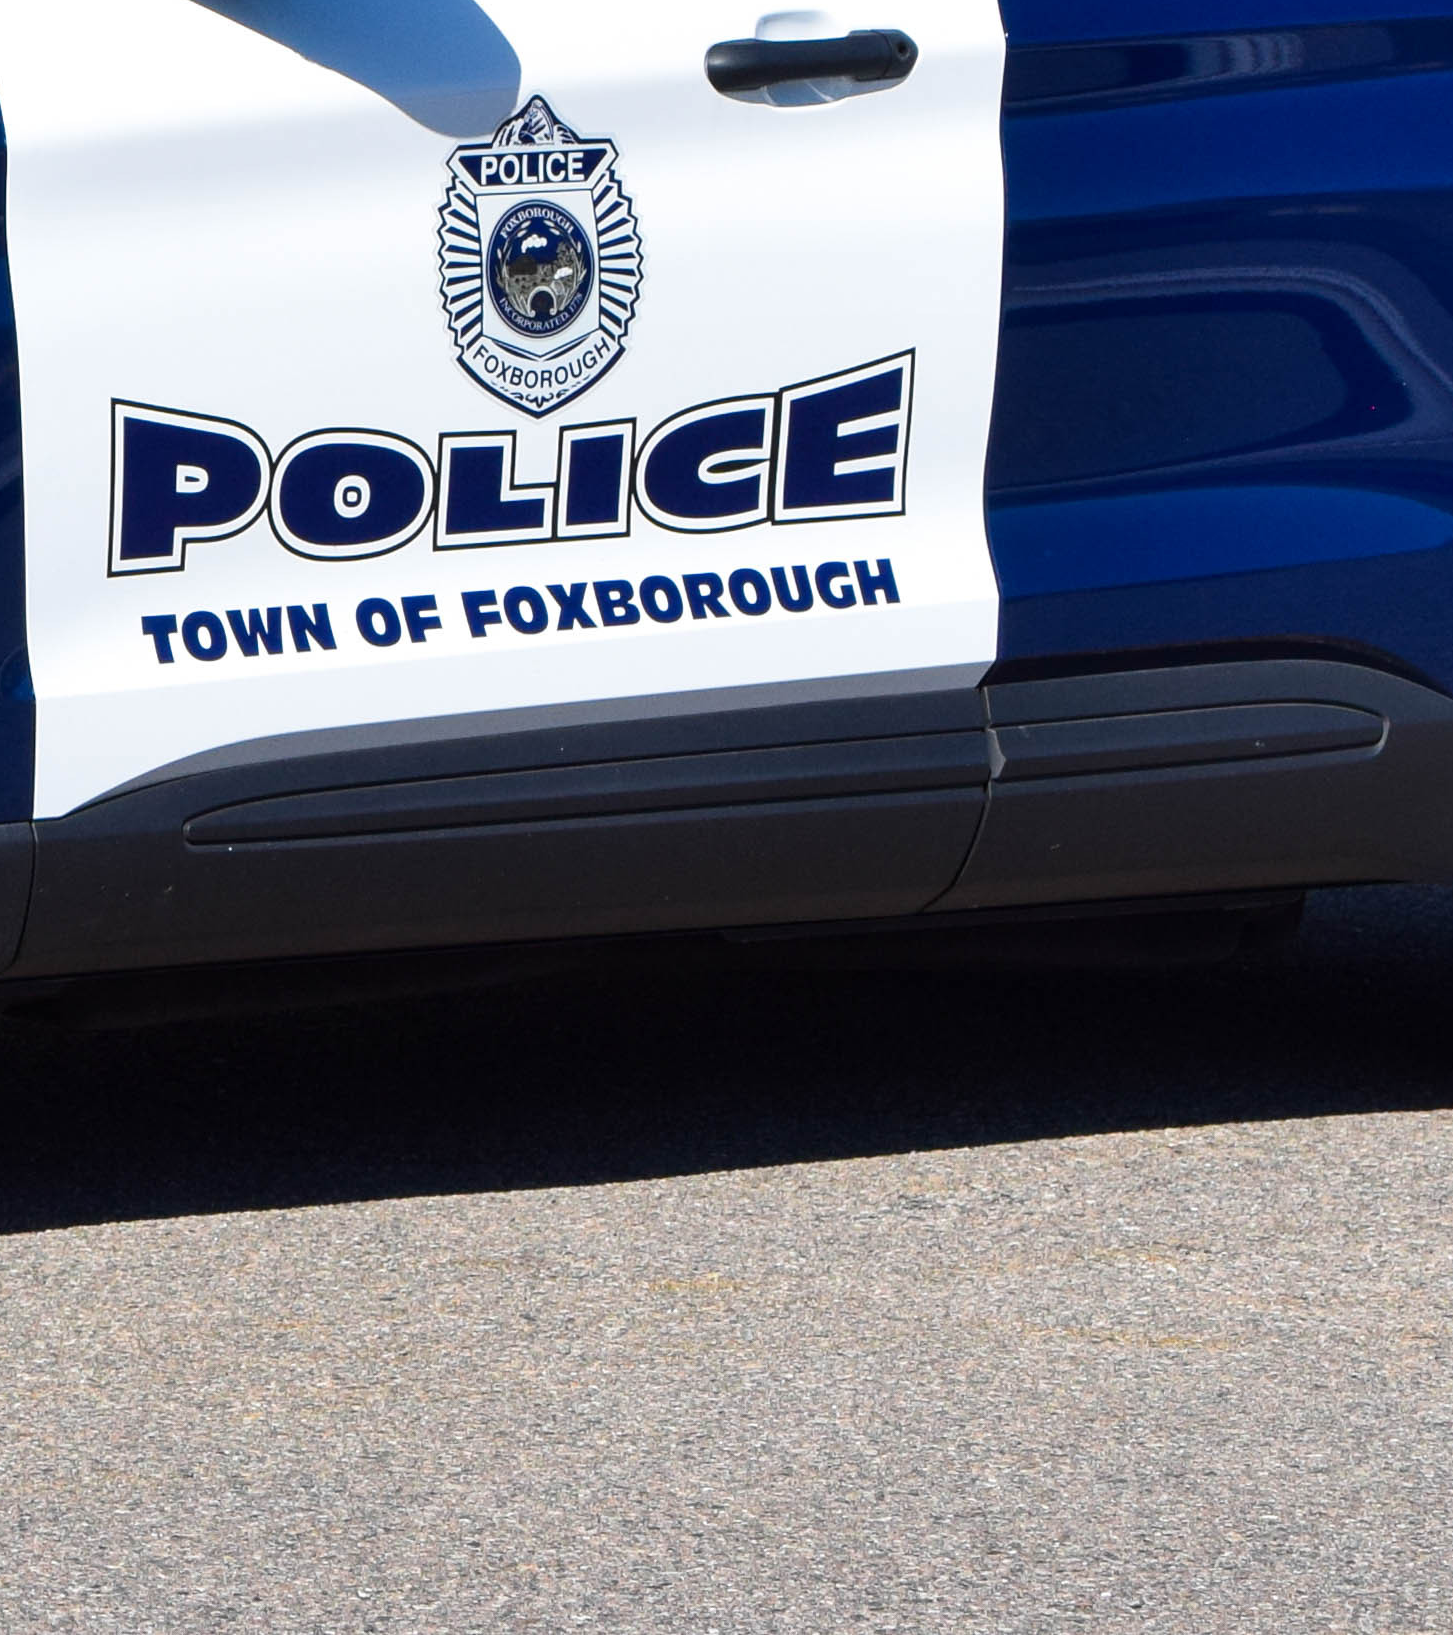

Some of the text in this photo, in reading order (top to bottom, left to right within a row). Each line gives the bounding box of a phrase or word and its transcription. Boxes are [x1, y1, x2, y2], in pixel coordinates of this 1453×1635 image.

[480, 152, 586, 185] POLICE
[499, 207, 575, 240] FOXBOROUGH
[472, 337, 611, 388] FOXBOROUGH
[107, 348, 916, 577] POLICE
[141, 558, 901, 664] TOWN OF FOXBOROUGH
